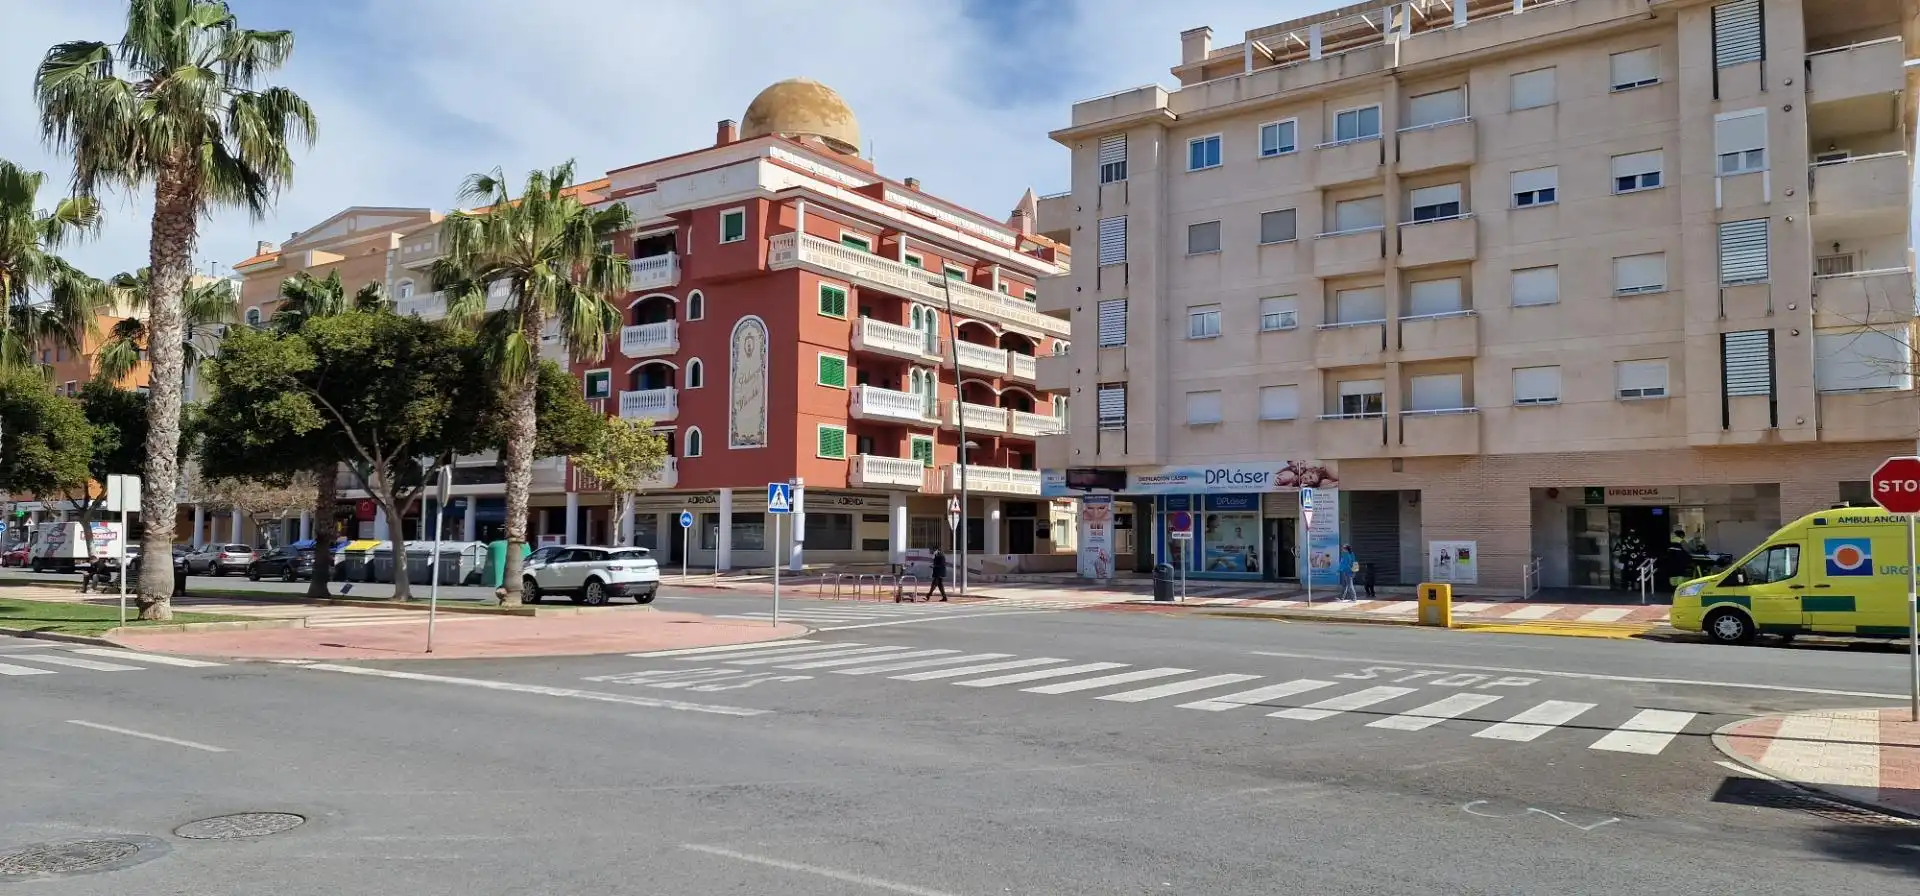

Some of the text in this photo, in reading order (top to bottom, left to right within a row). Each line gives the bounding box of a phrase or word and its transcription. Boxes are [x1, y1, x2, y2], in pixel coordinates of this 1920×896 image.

[1878, 479, 1920, 493] STO
[1609, 488, 1658, 496] URGENCIAS
[1838, 515, 1907, 524] AMBULANCIA
[1331, 666, 1543, 689] STOP
